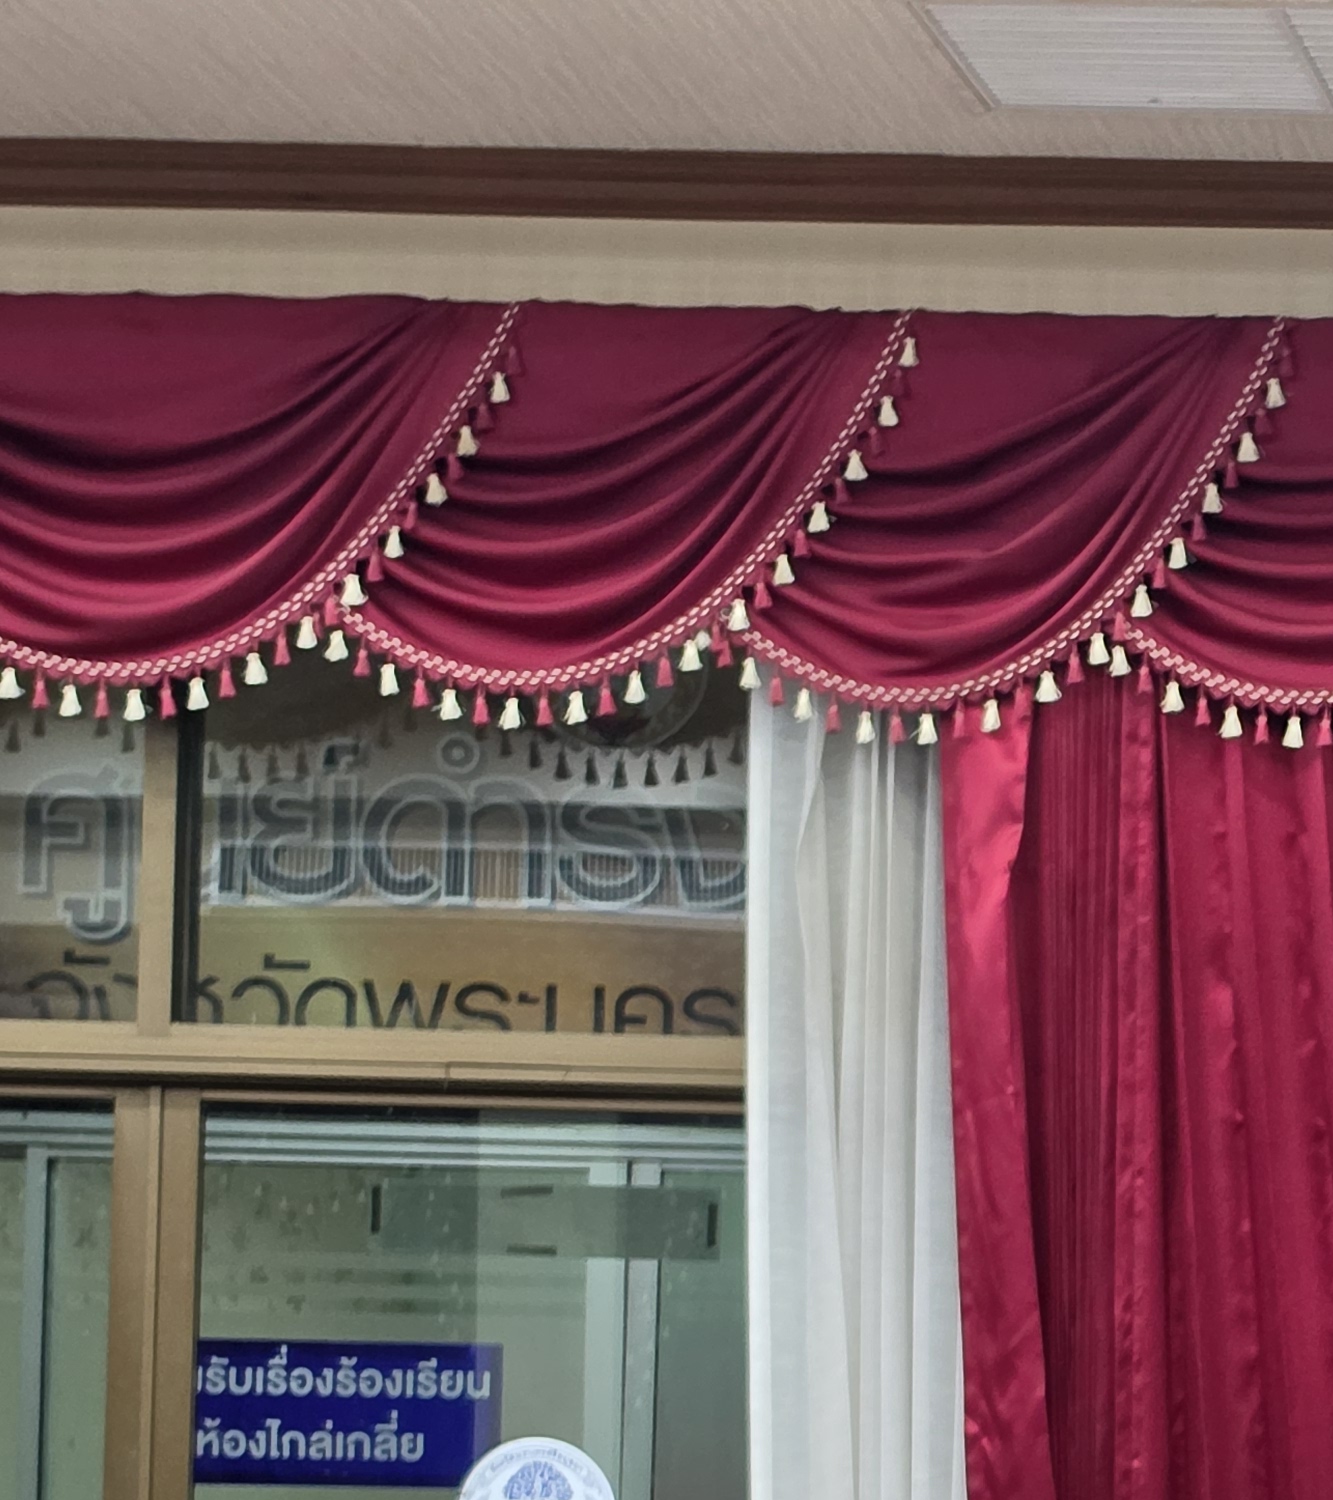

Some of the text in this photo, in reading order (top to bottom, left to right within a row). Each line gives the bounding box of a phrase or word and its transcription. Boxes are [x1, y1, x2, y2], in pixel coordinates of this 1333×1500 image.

[196, 1344, 491, 1399] รับเรื่องร้องเรียน
